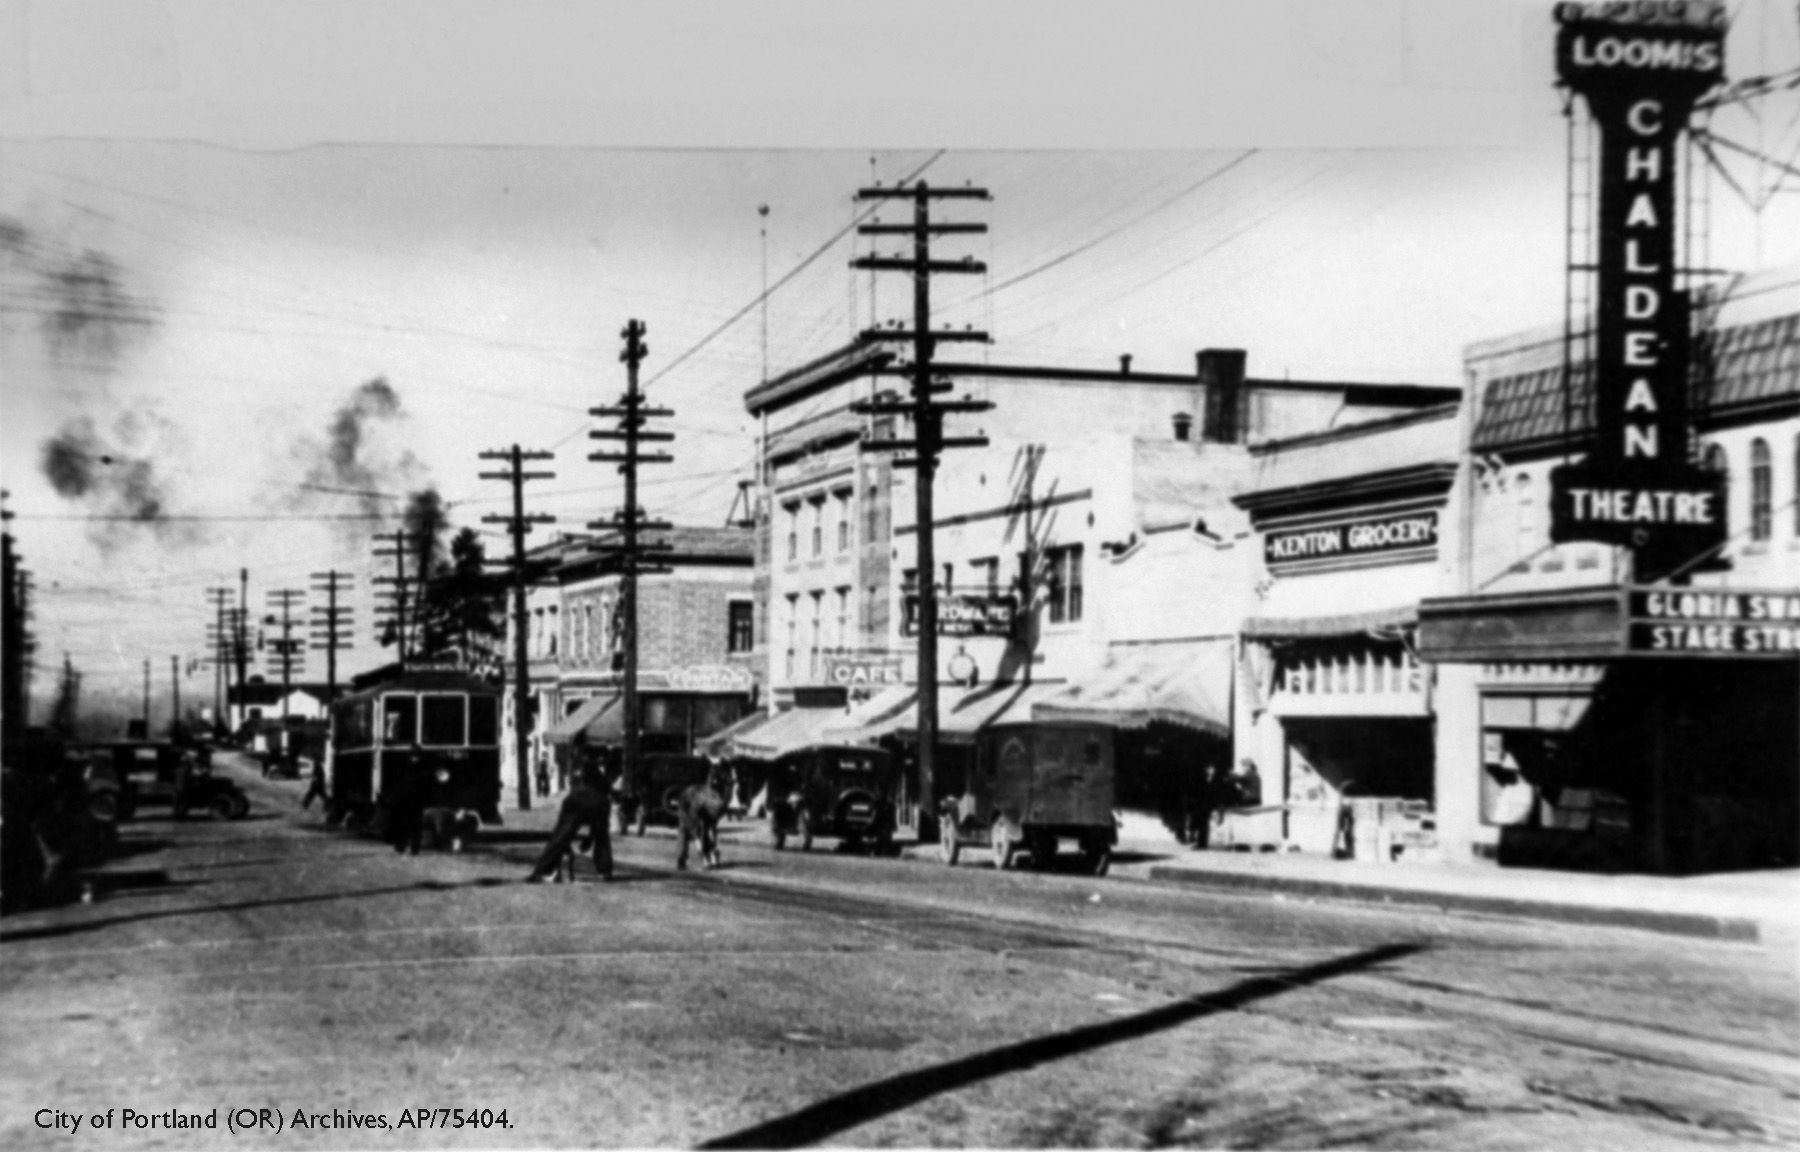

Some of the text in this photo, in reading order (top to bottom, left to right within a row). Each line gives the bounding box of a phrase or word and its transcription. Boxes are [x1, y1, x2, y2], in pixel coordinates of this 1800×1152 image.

[1624, 100, 1662, 457] CHALDEAN
[1568, 488, 1715, 524] THEATRE
[1273, 517, 1431, 558] KENTON GROCERY
[1648, 594, 1739, 616] GLORIA
[1652, 626, 1734, 649] STAGE
